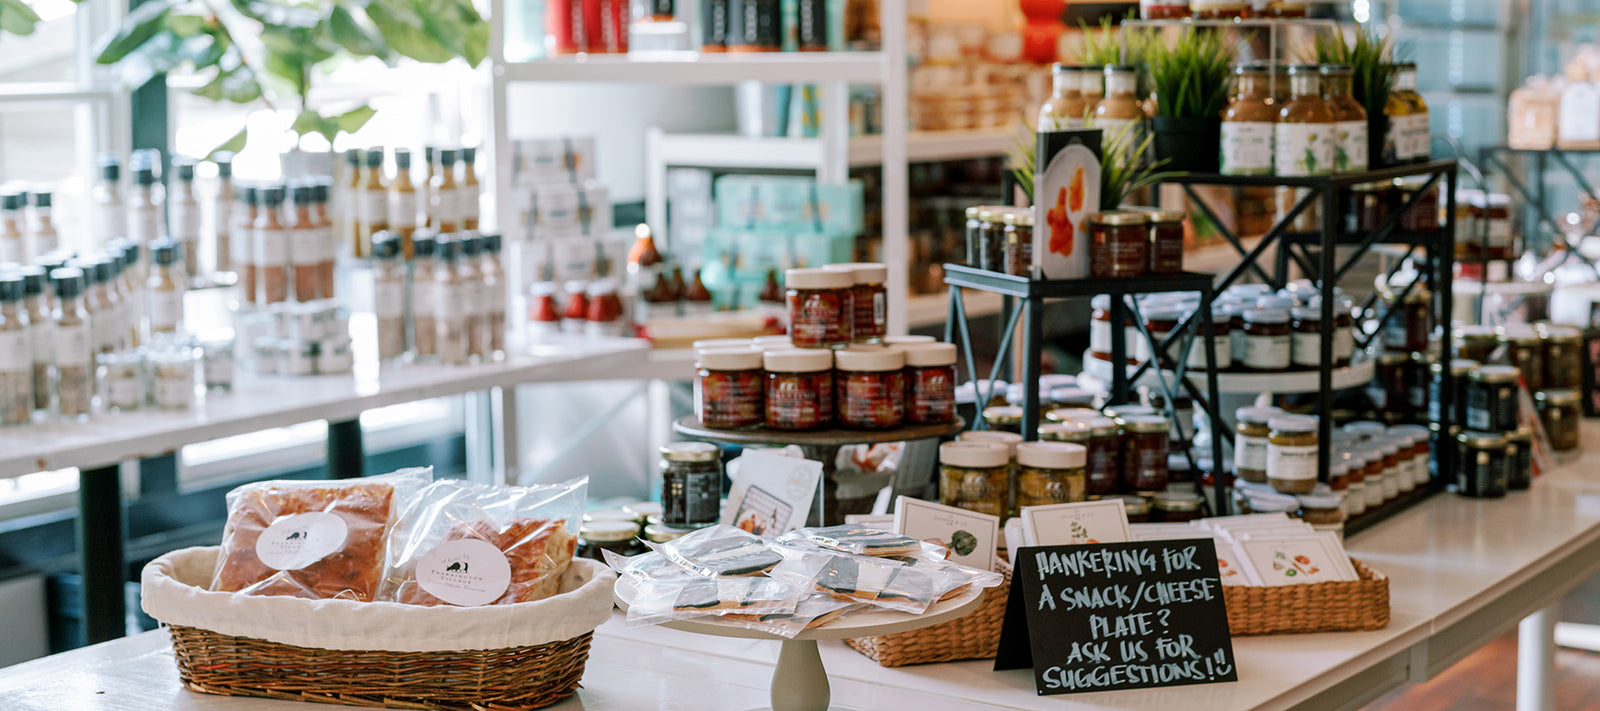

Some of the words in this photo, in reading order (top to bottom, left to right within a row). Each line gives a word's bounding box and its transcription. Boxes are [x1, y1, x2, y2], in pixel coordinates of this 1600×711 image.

[1035, 548, 1157, 581] HANKERING
[1161, 546, 1202, 574] FOR
[1038, 583, 1056, 611] A
[1060, 578, 1219, 611] SNACK/CHEESE
[1066, 641, 1111, 664] ASK
[1120, 640, 1148, 662] US
[1155, 634, 1202, 660] FOR
